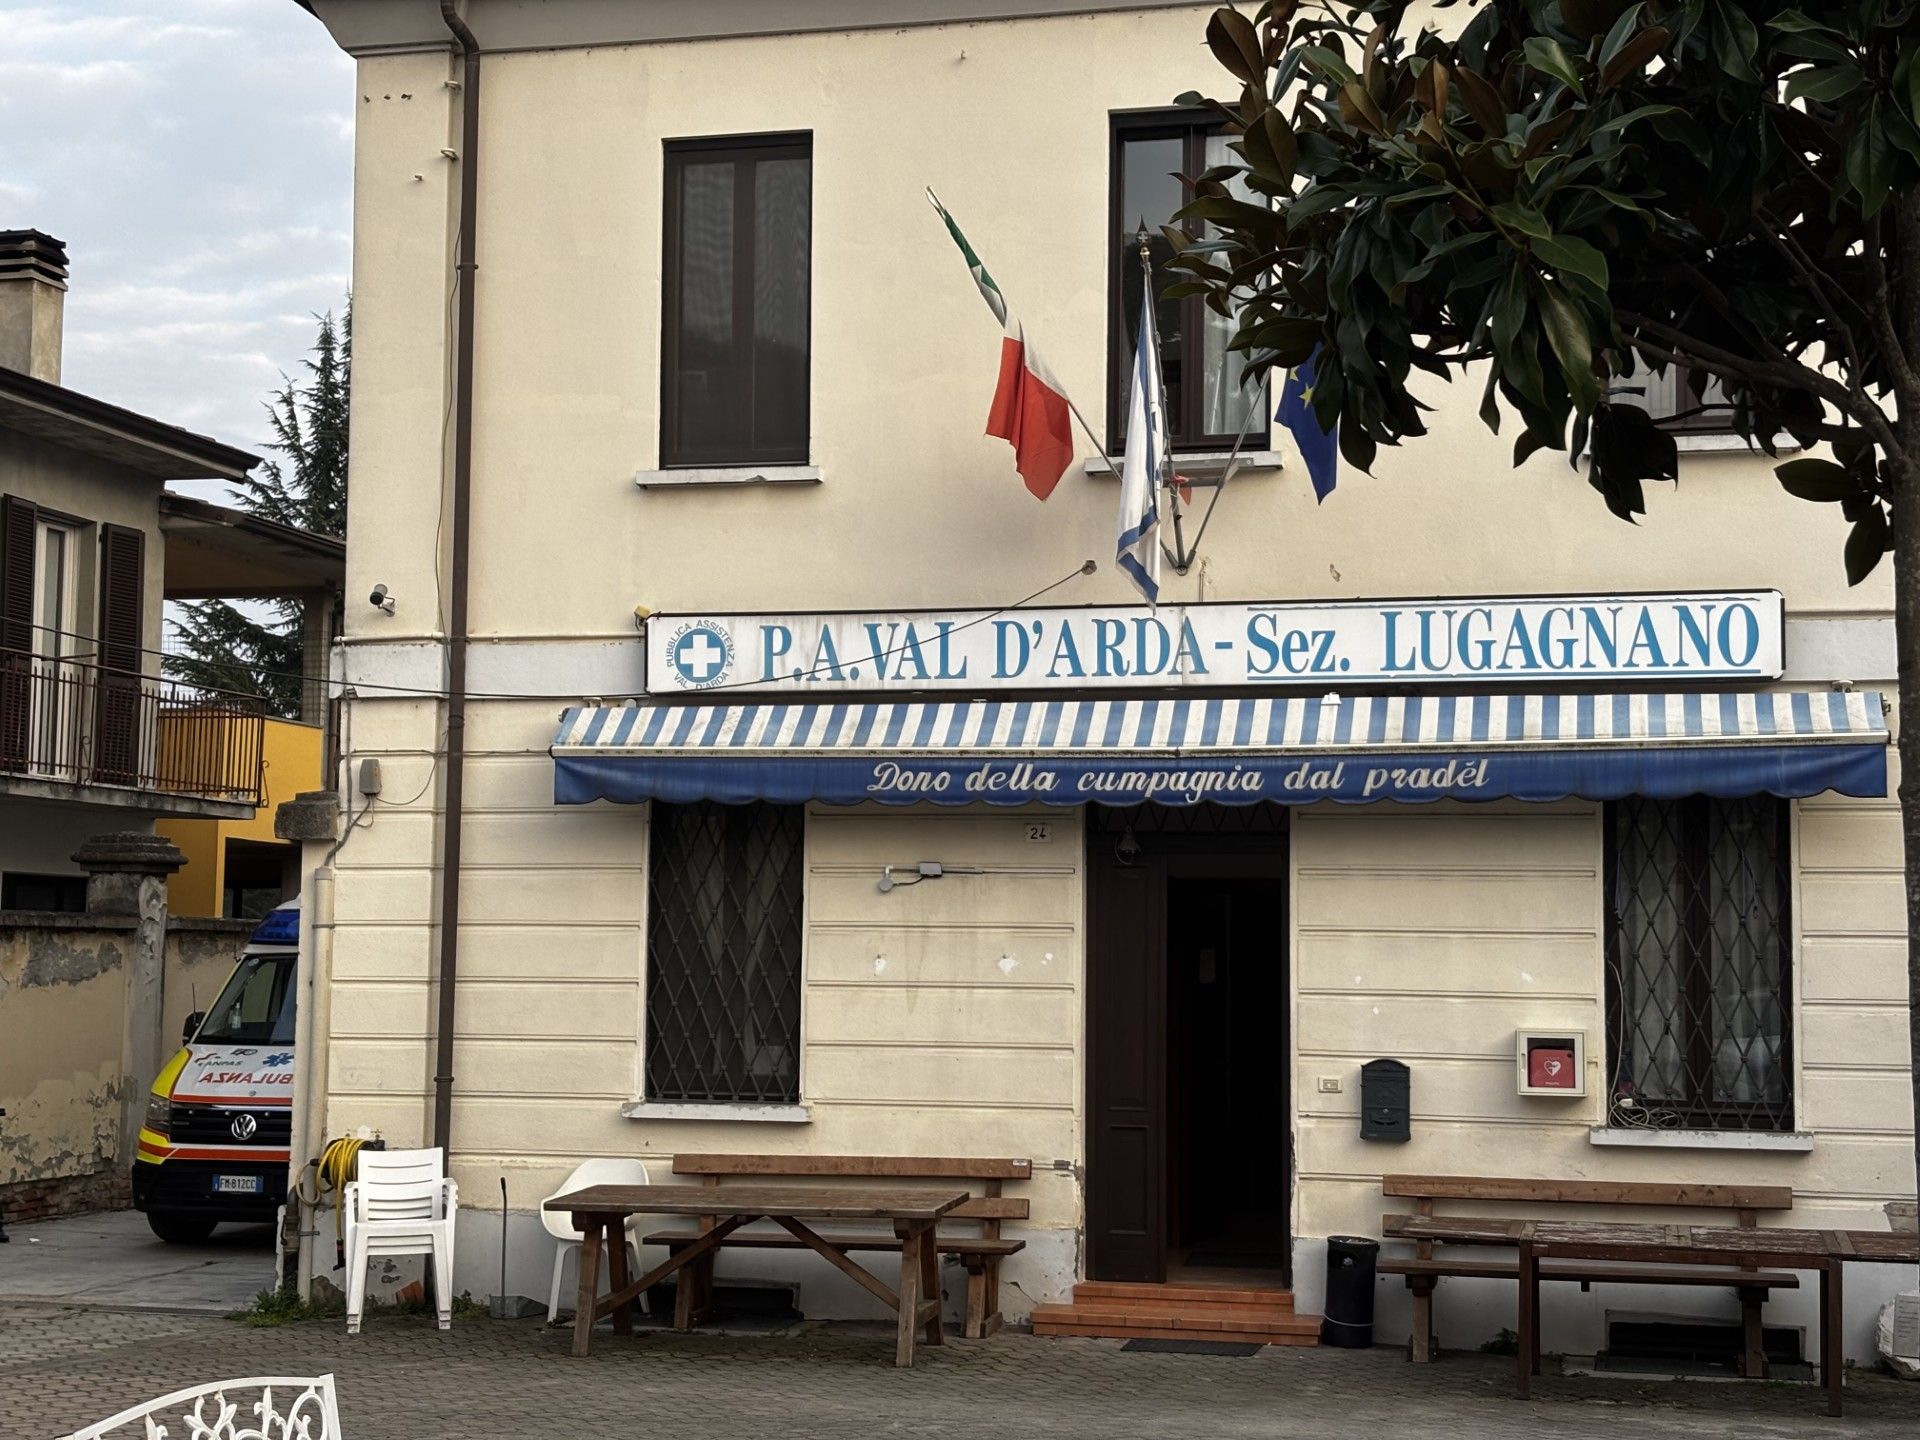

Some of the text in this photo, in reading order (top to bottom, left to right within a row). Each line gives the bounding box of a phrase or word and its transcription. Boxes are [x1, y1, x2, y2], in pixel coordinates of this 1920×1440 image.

[666, 619, 735, 667] PUBBLICA ASSISTENZA
[1380, 603, 1760, 672] LUGAGNANO
[674, 673, 688, 688] VAL
[867, 761, 952, 792] Dono
[965, 762, 1060, 792] della
[1077, 764, 1265, 804] cumpagnia
[1284, 761, 1344, 790] dal
[1030, 827, 1047, 840] 24
